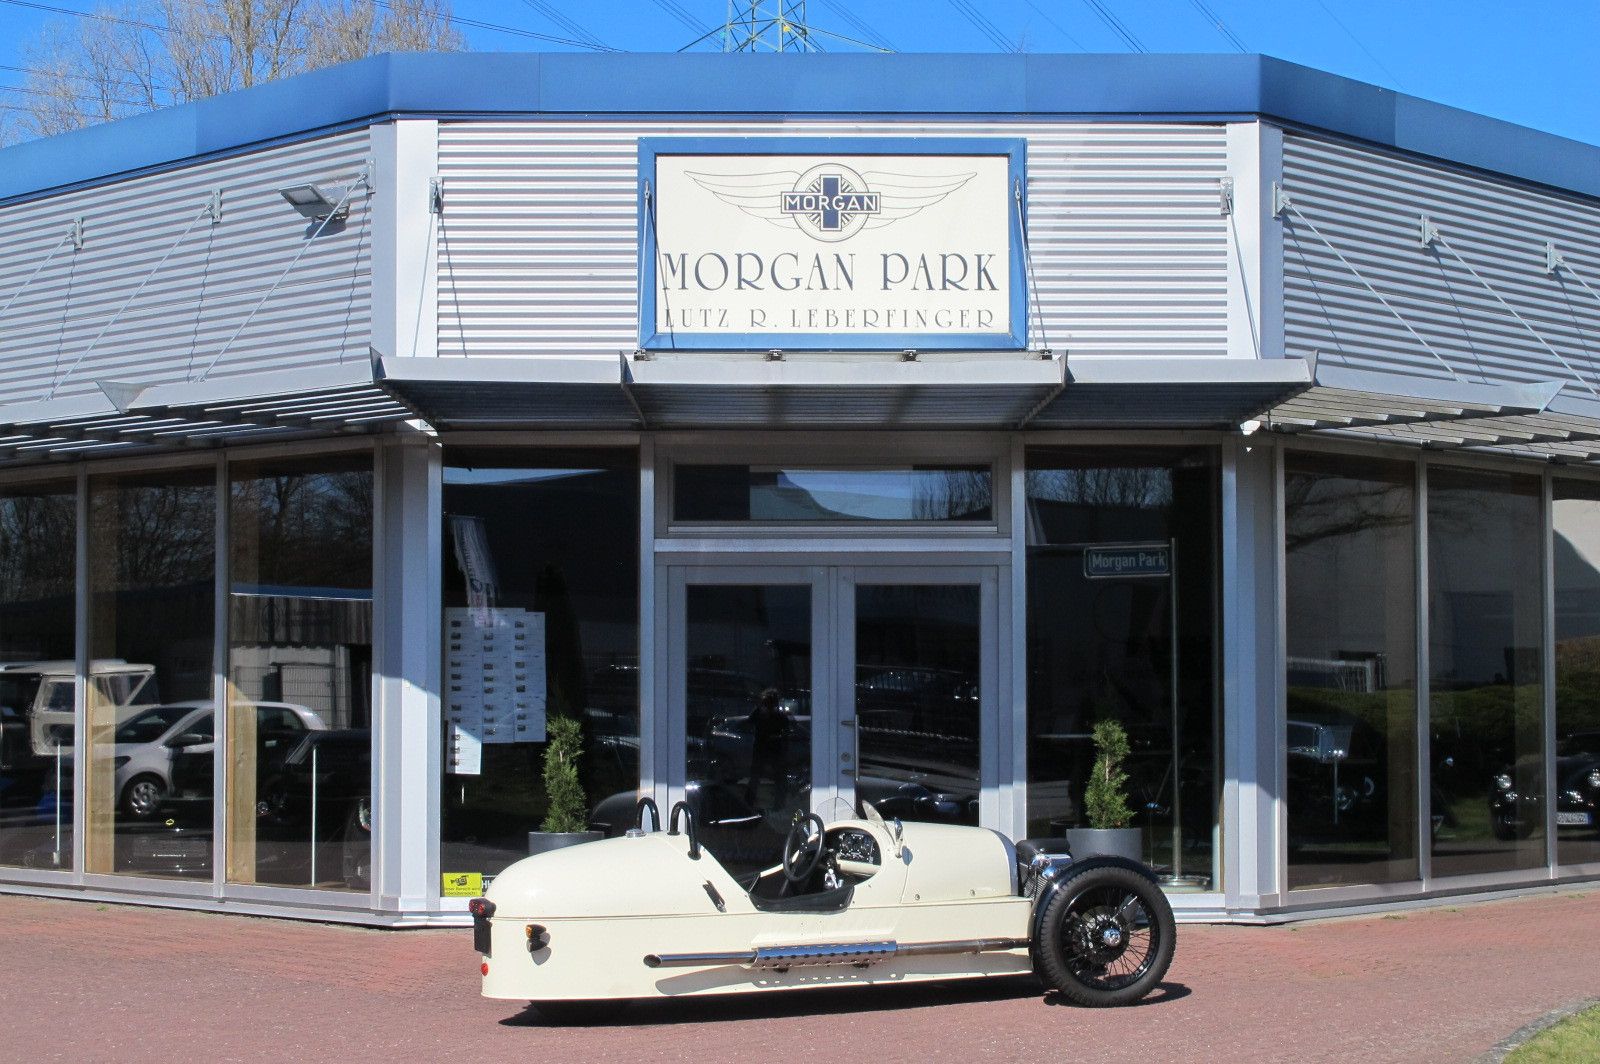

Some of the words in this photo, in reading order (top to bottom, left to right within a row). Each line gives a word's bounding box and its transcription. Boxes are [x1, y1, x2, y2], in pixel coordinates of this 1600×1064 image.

[785, 195, 876, 211] MORGAN
[662, 252, 856, 291] MORGAN
[880, 252, 999, 291] PARK
[664, 308, 729, 328] LUTZ
[750, 308, 777, 328] R.
[791, 308, 994, 328] LEBERFINGER
[1092, 553, 1136, 571] Morgan
[1138, 551, 1165, 567] Park
